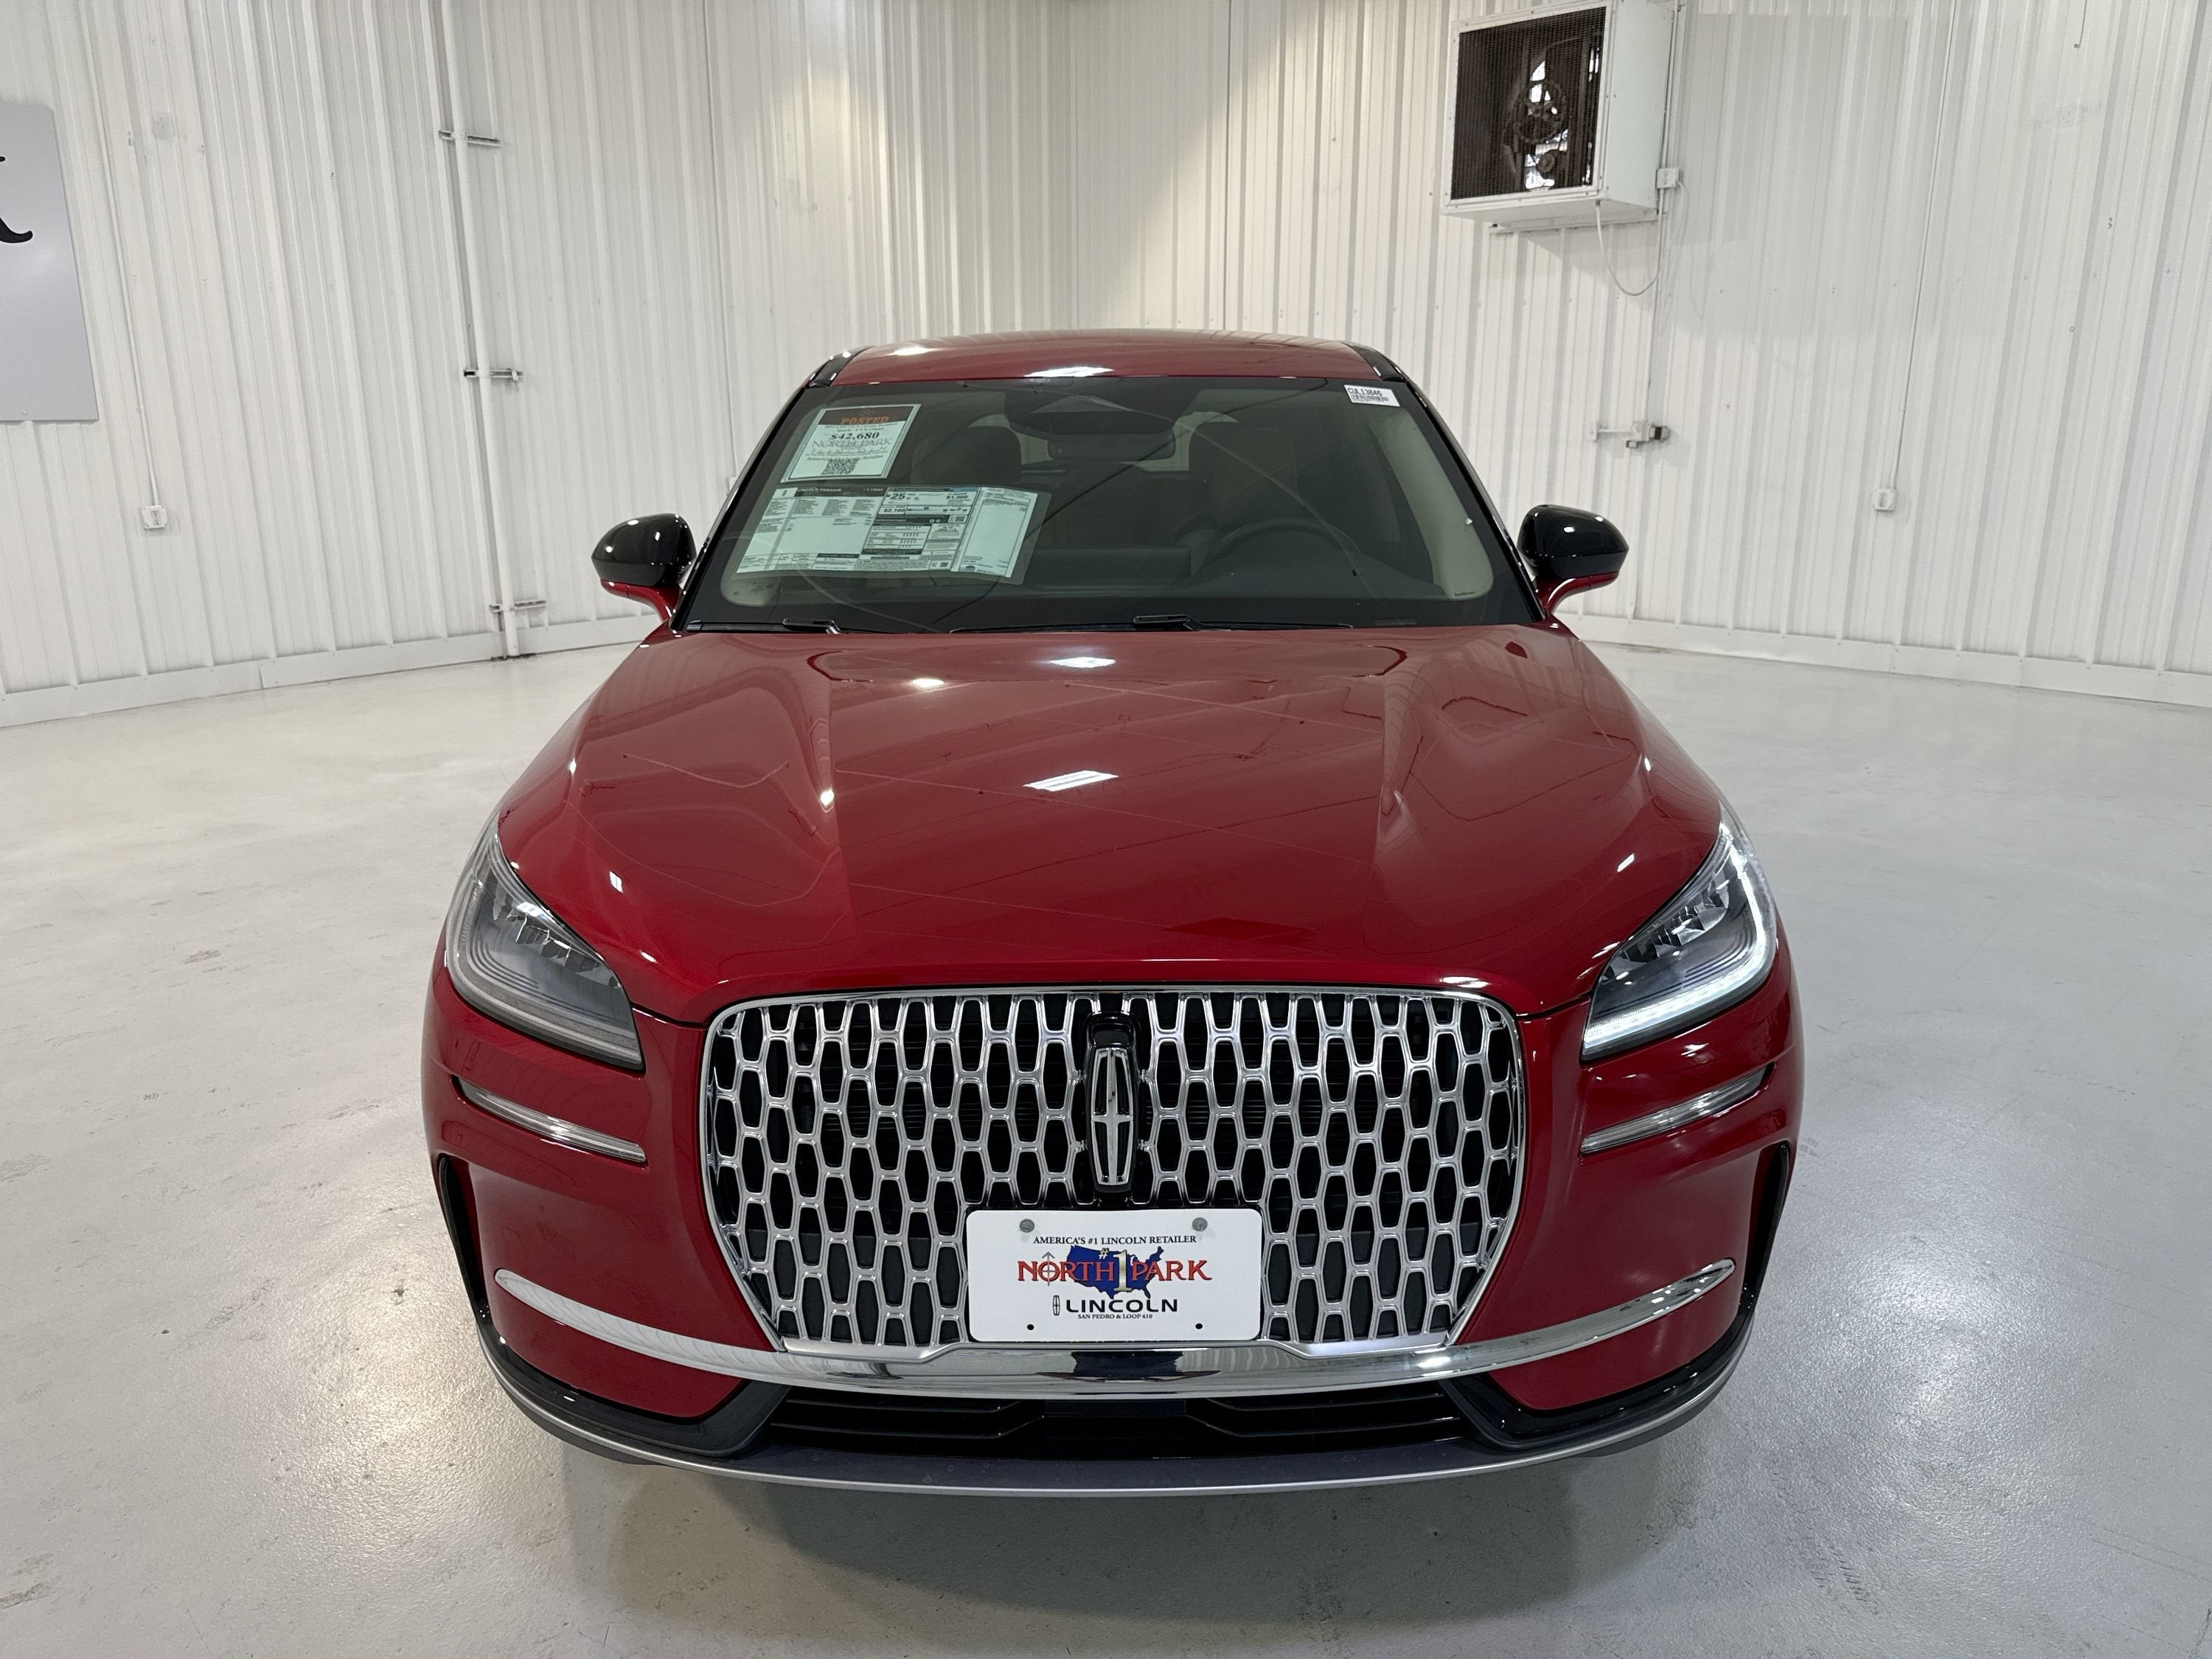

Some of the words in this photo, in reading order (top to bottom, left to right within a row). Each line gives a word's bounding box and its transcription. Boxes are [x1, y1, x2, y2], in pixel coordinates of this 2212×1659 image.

[841, 417, 889, 425] POSTED
[1033, 1237, 1085, 1245] AMERICA'S
[1101, 1237, 1147, 1245] LINCOLN
[1149, 1235, 1197, 1244] RETAILER
[1017, 1260, 1115, 1282] NORTH
[1132, 1259, 1213, 1281] PARK
[1066, 1299, 1178, 1313] LINCOLN
